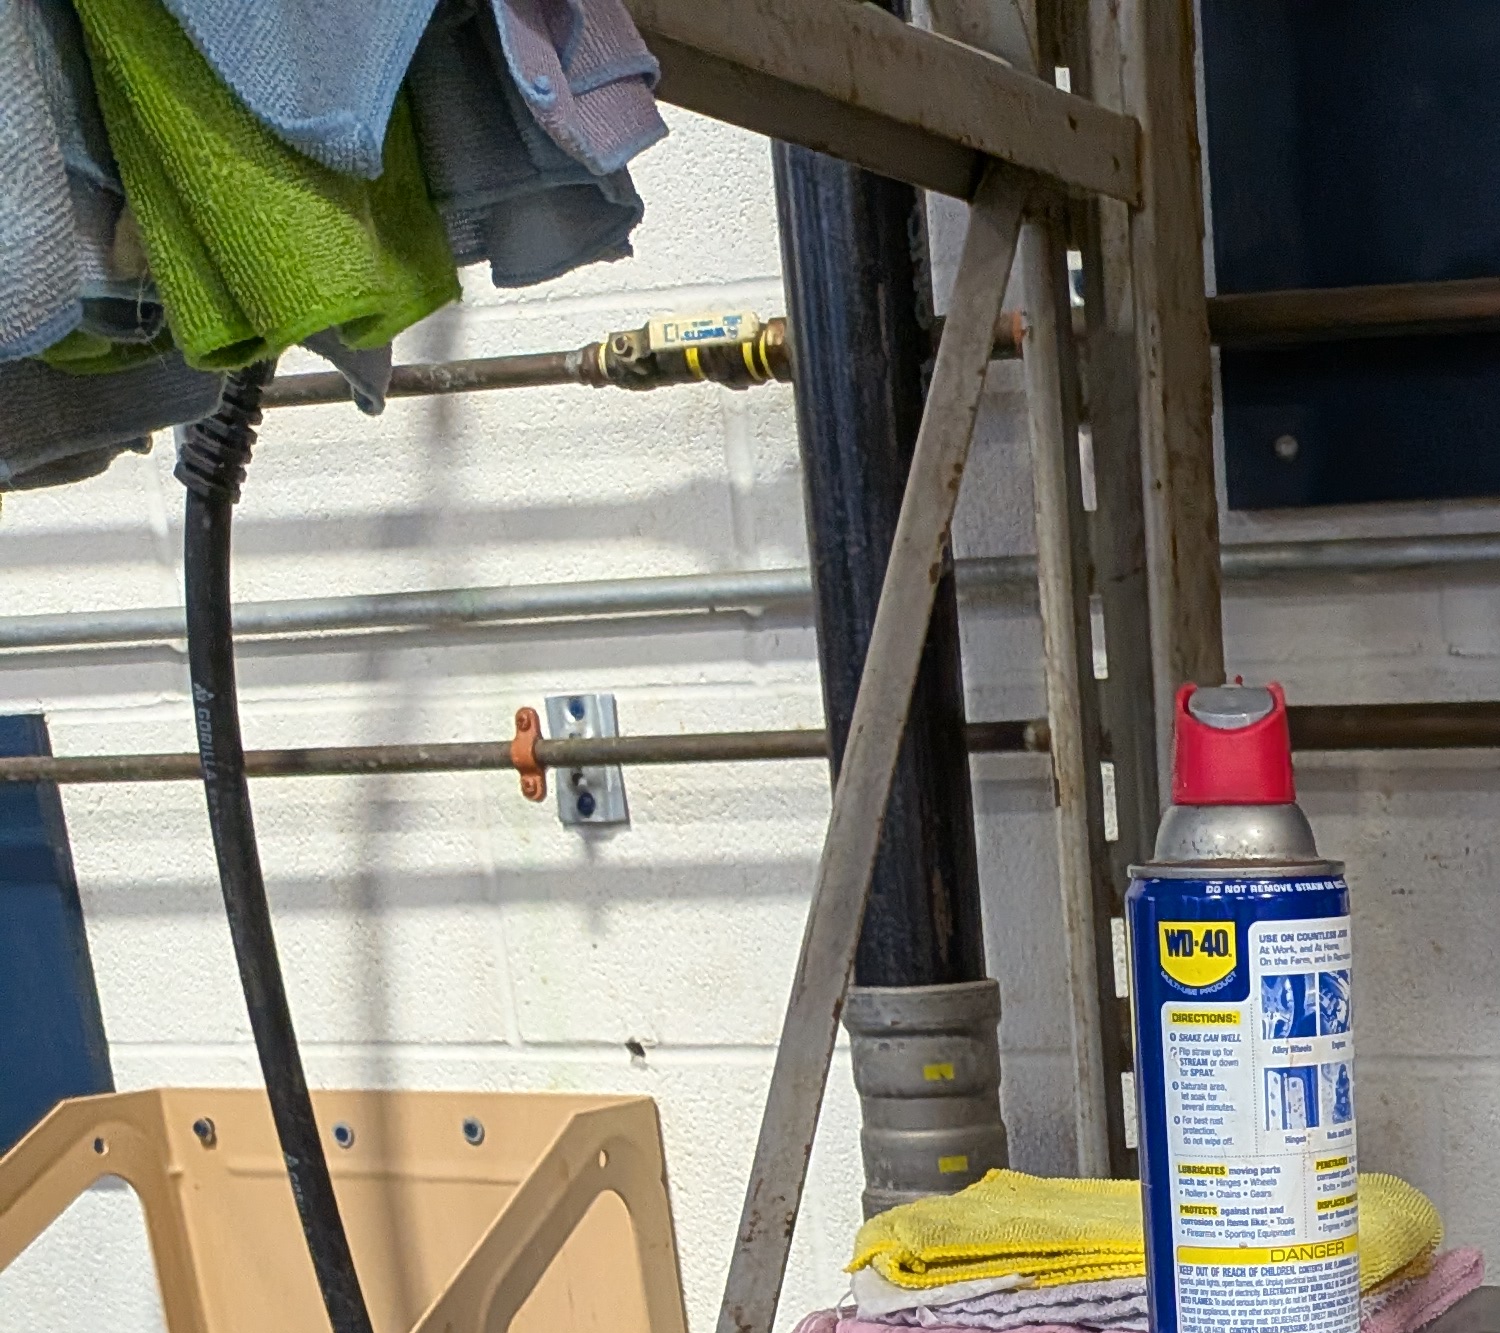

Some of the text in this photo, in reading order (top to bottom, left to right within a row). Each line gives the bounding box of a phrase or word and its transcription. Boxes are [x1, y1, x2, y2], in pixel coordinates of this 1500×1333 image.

[197, 707, 218, 781] GORILLA
[1206, 885, 1221, 893] DO
[1225, 885, 1247, 893] NOT
[1250, 884, 1293, 893] REMOVE
[1259, 931, 1336, 943] USE ON COUNTLESS
[1164, 928, 1229, 958] WD-40
[1260, 946, 1269, 954] At
[1260, 957, 1271, 966] On
[1274, 957, 1288, 965] the
[1160, 971, 1236, 996] MULTI-USE PRODUCT
[1172, 1013, 1237, 1024] DIRECTIONS:
[1179, 1033, 1201, 1042] SHAKE
[1201, 1034, 1219, 1042] CAN
[1179, 1047, 1233, 1057] Flip straw up for
[1179, 1058, 1208, 1066] STREAM
[1219, 1058, 1239, 1066] down
[1180, 1068, 1188, 1076] for
[1181, 1082, 1207, 1090] Saturate
[1182, 1116, 1223, 1125] For best rust
[1183, 1127, 1217, 1135] protection,
[1205, 1138, 1220, 1147] wipe
[1178, 1165, 1281, 1176] LUBRICATES moving parts
[1216, 1179, 1241, 1188] Hinges
[1250, 1177, 1277, 1186] Wheels
[1185, 1189, 1272, 1198] Rollers Chains Gears
[1180, 1205, 1284, 1216] PROTECTS against rust and
[1181, 1218, 1213, 1226] corrosion
[1276, 1217, 1294, 1225] Tools
[1187, 1228, 1296, 1239] Firearms Sporting Equipment
[1271, 1241, 1344, 1263] DANGER
[1180, 1265, 1193, 1275] KEEP
[1196, 1266, 1208, 1276] OUT
[1211, 1267, 1220, 1277] OF
[1223, 1267, 1246, 1277] REACH
[1249, 1267, 1258, 1277] OF
